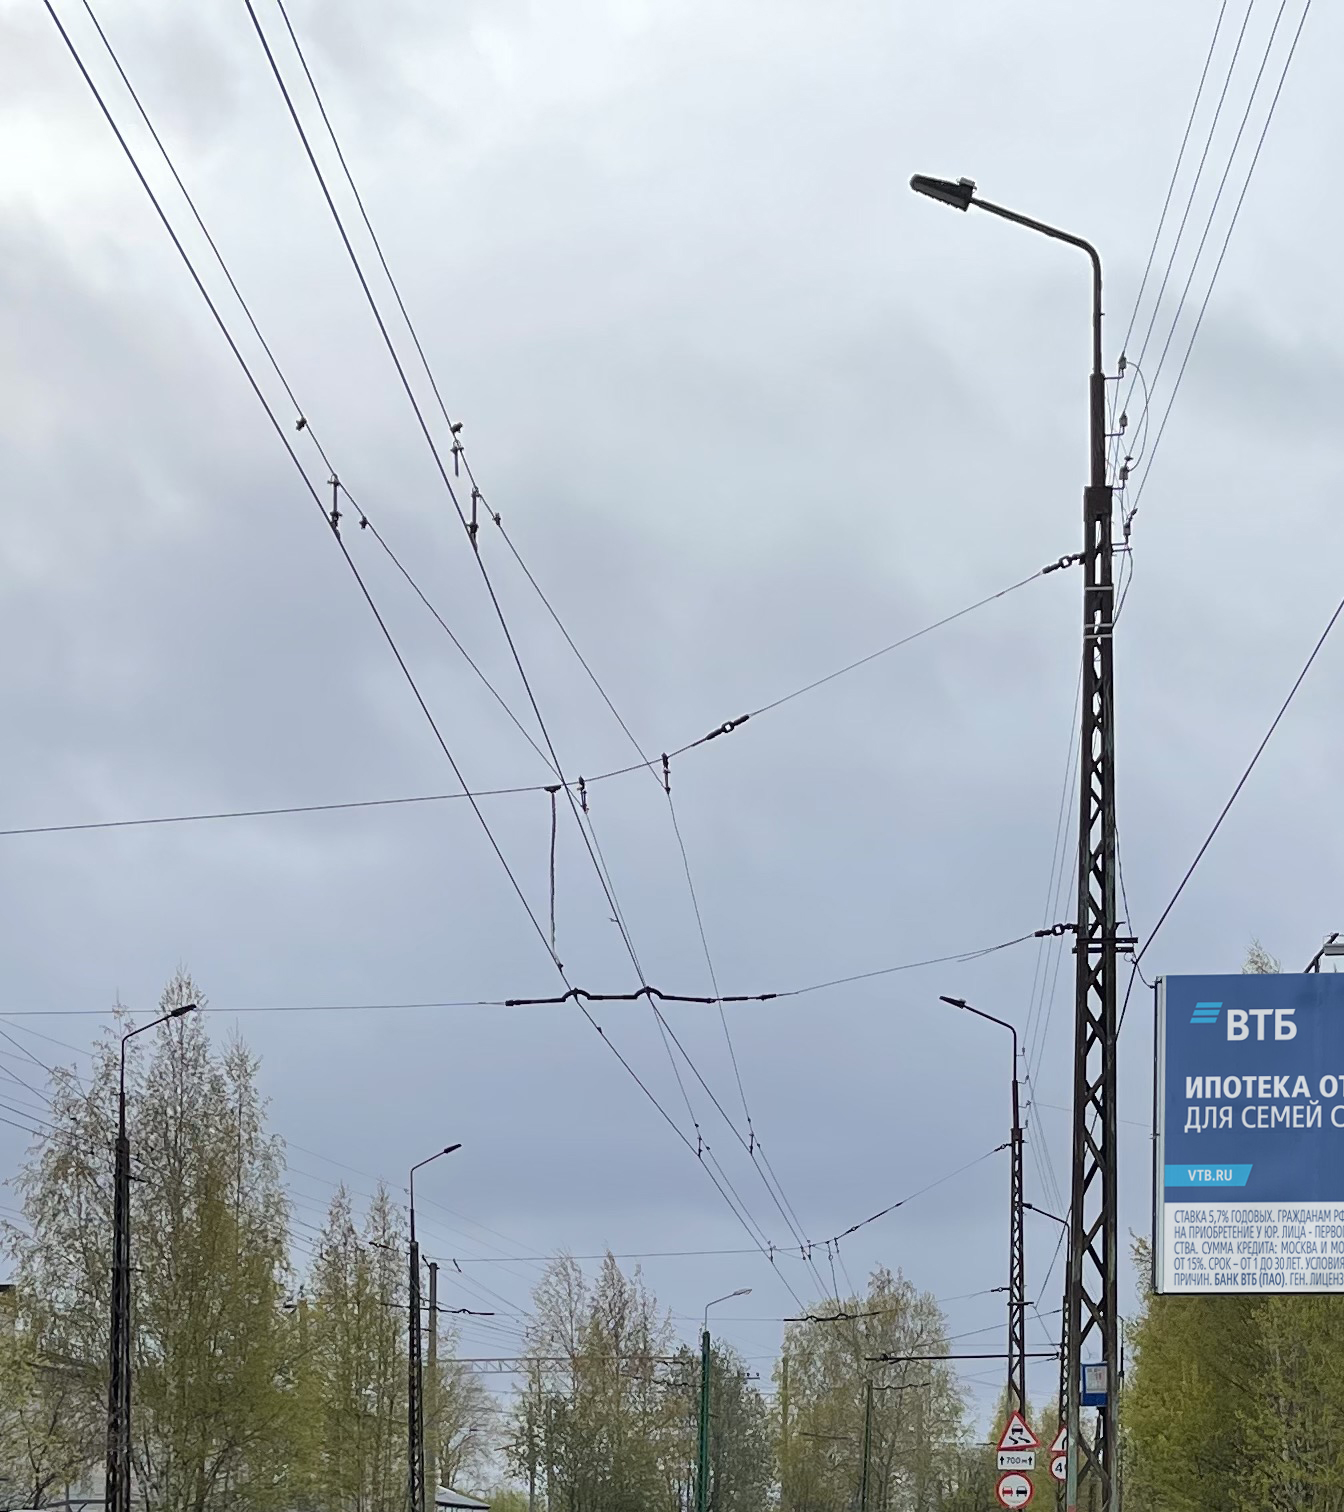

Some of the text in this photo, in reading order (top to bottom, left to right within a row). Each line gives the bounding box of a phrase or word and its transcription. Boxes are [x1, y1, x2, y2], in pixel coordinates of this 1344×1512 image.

[1227, 1008, 1297, 1041] ВТБ
[1185, 1075, 1311, 1099] ИПОТЕКА
[1184, 1105, 1233, 1133] ДЛЯ
[1241, 1099, 1322, 1128] СЕМЕЙ
[1188, 1169, 1233, 1182] VTB.RU
[1174, 1210, 1207, 1223] СТАВКА
[1208, 1210, 1229, 1225] 5,7%
[1231, 1209, 1275, 1224] ГОДОВЫХ.
[1278, 1209, 1331, 1224] ГРАЖДАНАМ
[1174, 1226, 1187, 1238] НА
[1188, 1225, 1255, 1238] ПРИОБРЕТЕНИЕ
[1255, 1225, 1263, 1238] У
[1264, 1225, 1280, 1238] ЮР.
[1281, 1225, 1307, 1240] ЛИЦА
[1173, 1241, 1199, 1254] СТВА.
[1201, 1241, 1234, 1254] СУММА
[1236, 1241, 1278, 1256] КРЕДИТА:
[1280, 1241, 1319, 1254] МОСКВА
[1320, 1241, 1328, 1254] И
[1174, 1257, 1186, 1270] ОТ
[1187, 1257, 1207, 1270] 15%.
[1208, 1257, 1232, 1270] СРОК
[1240, 1257, 1252, 1270] ОТ
[1253, 1257, 1258, 1270] 1
[1259, 1257, 1274, 1272] ДО
[1274, 1257, 1286, 1270] 30
[1286, 1257, 1304, 1270] ЛЕТ.
[1174, 1273, 1213, 1286] ПРИЧИН.
[1214, 1273, 1240, 1286] БАНК
[1241, 1273, 1258, 1286] ВТБ
[1258, 1273, 1288, 1288] (ПАО).
[1289, 1272, 1308, 1286] ГЕН.
[1006, 1456, 1021, 1465] 700
